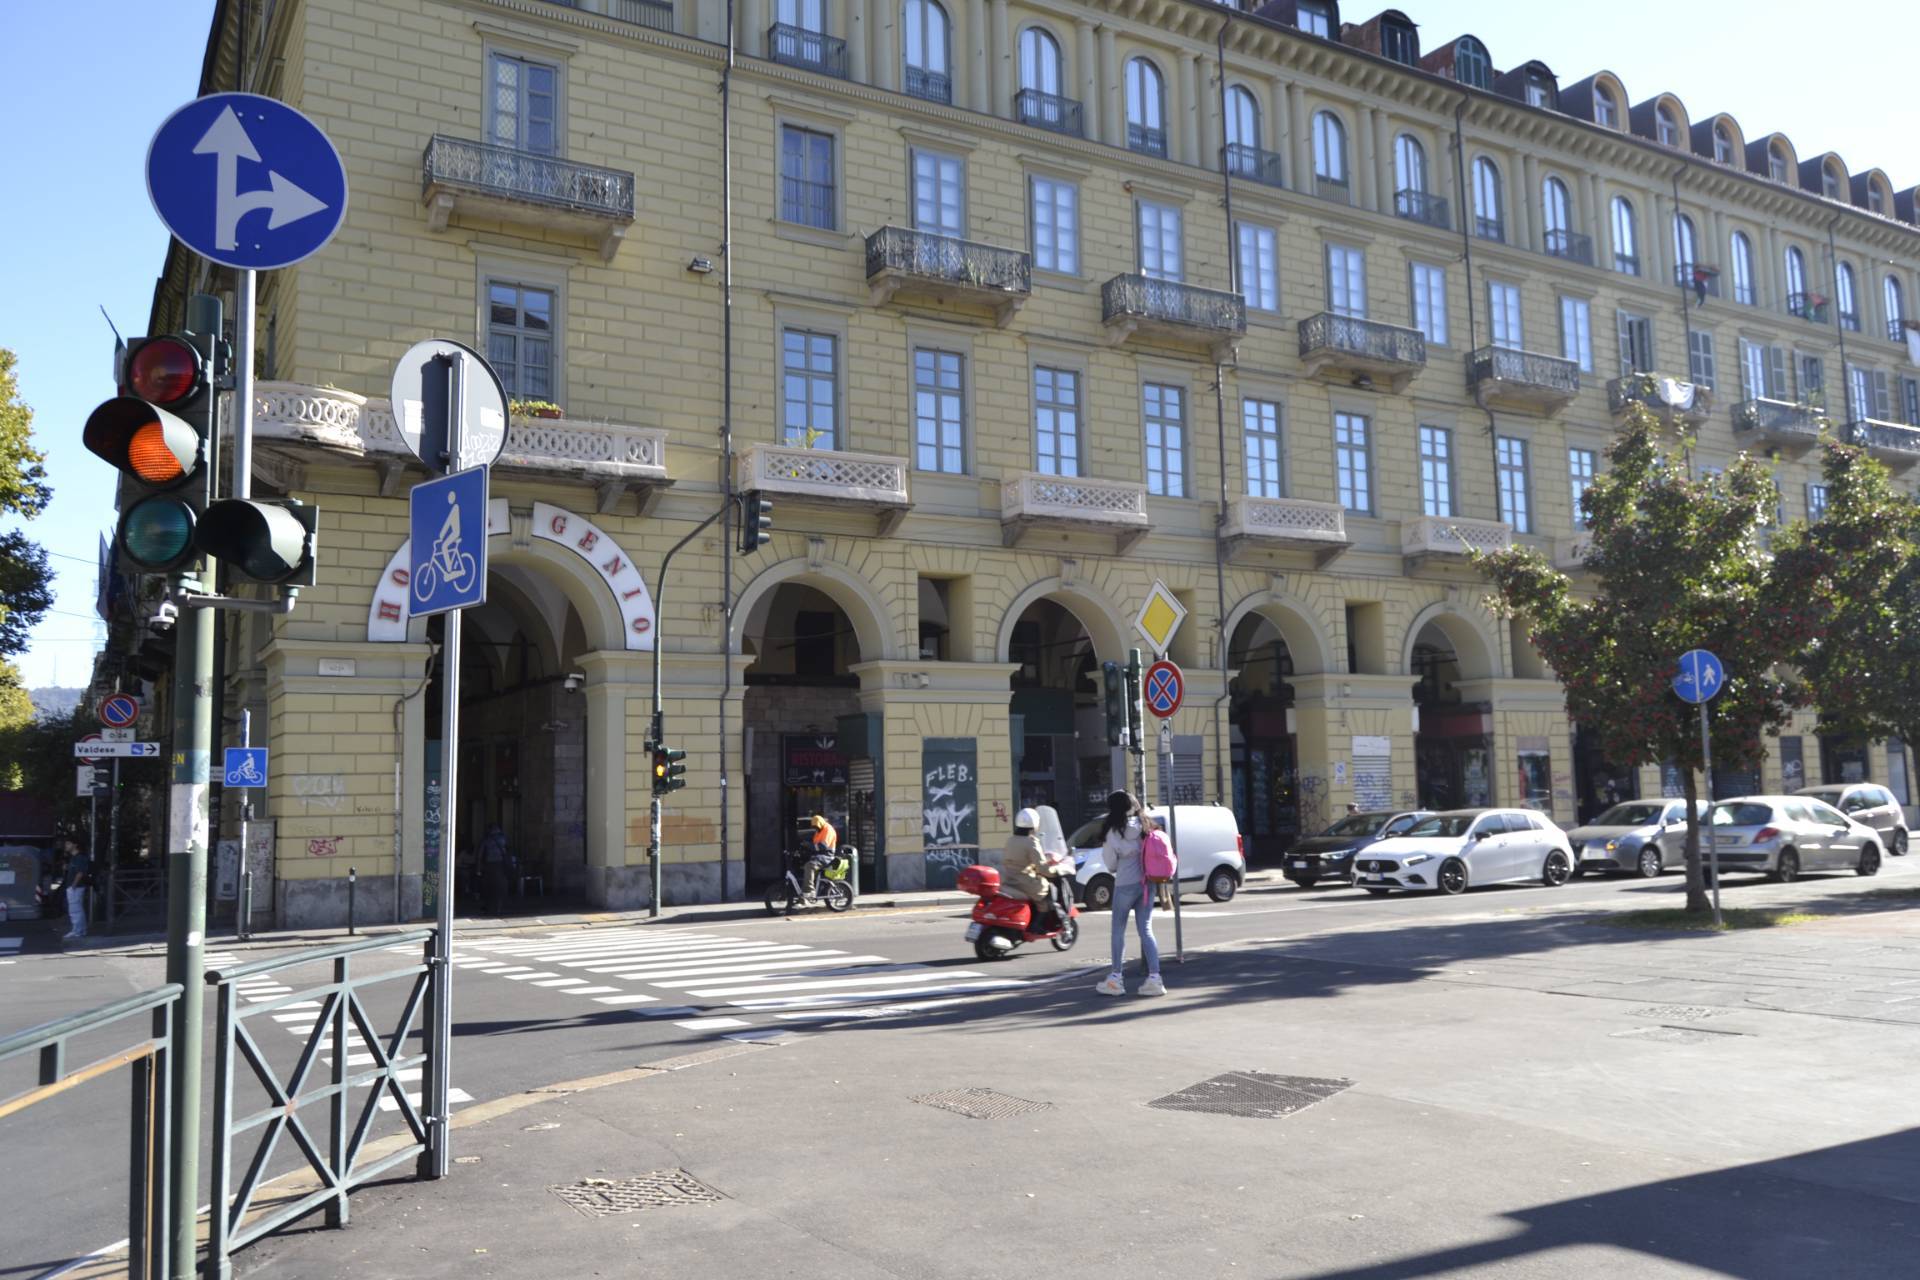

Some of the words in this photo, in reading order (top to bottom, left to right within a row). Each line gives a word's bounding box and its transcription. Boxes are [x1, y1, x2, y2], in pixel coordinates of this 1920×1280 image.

[551, 514, 651, 634] GENIO
[77, 745, 115, 753] Valdese
[926, 764, 973, 787] FLEB.
